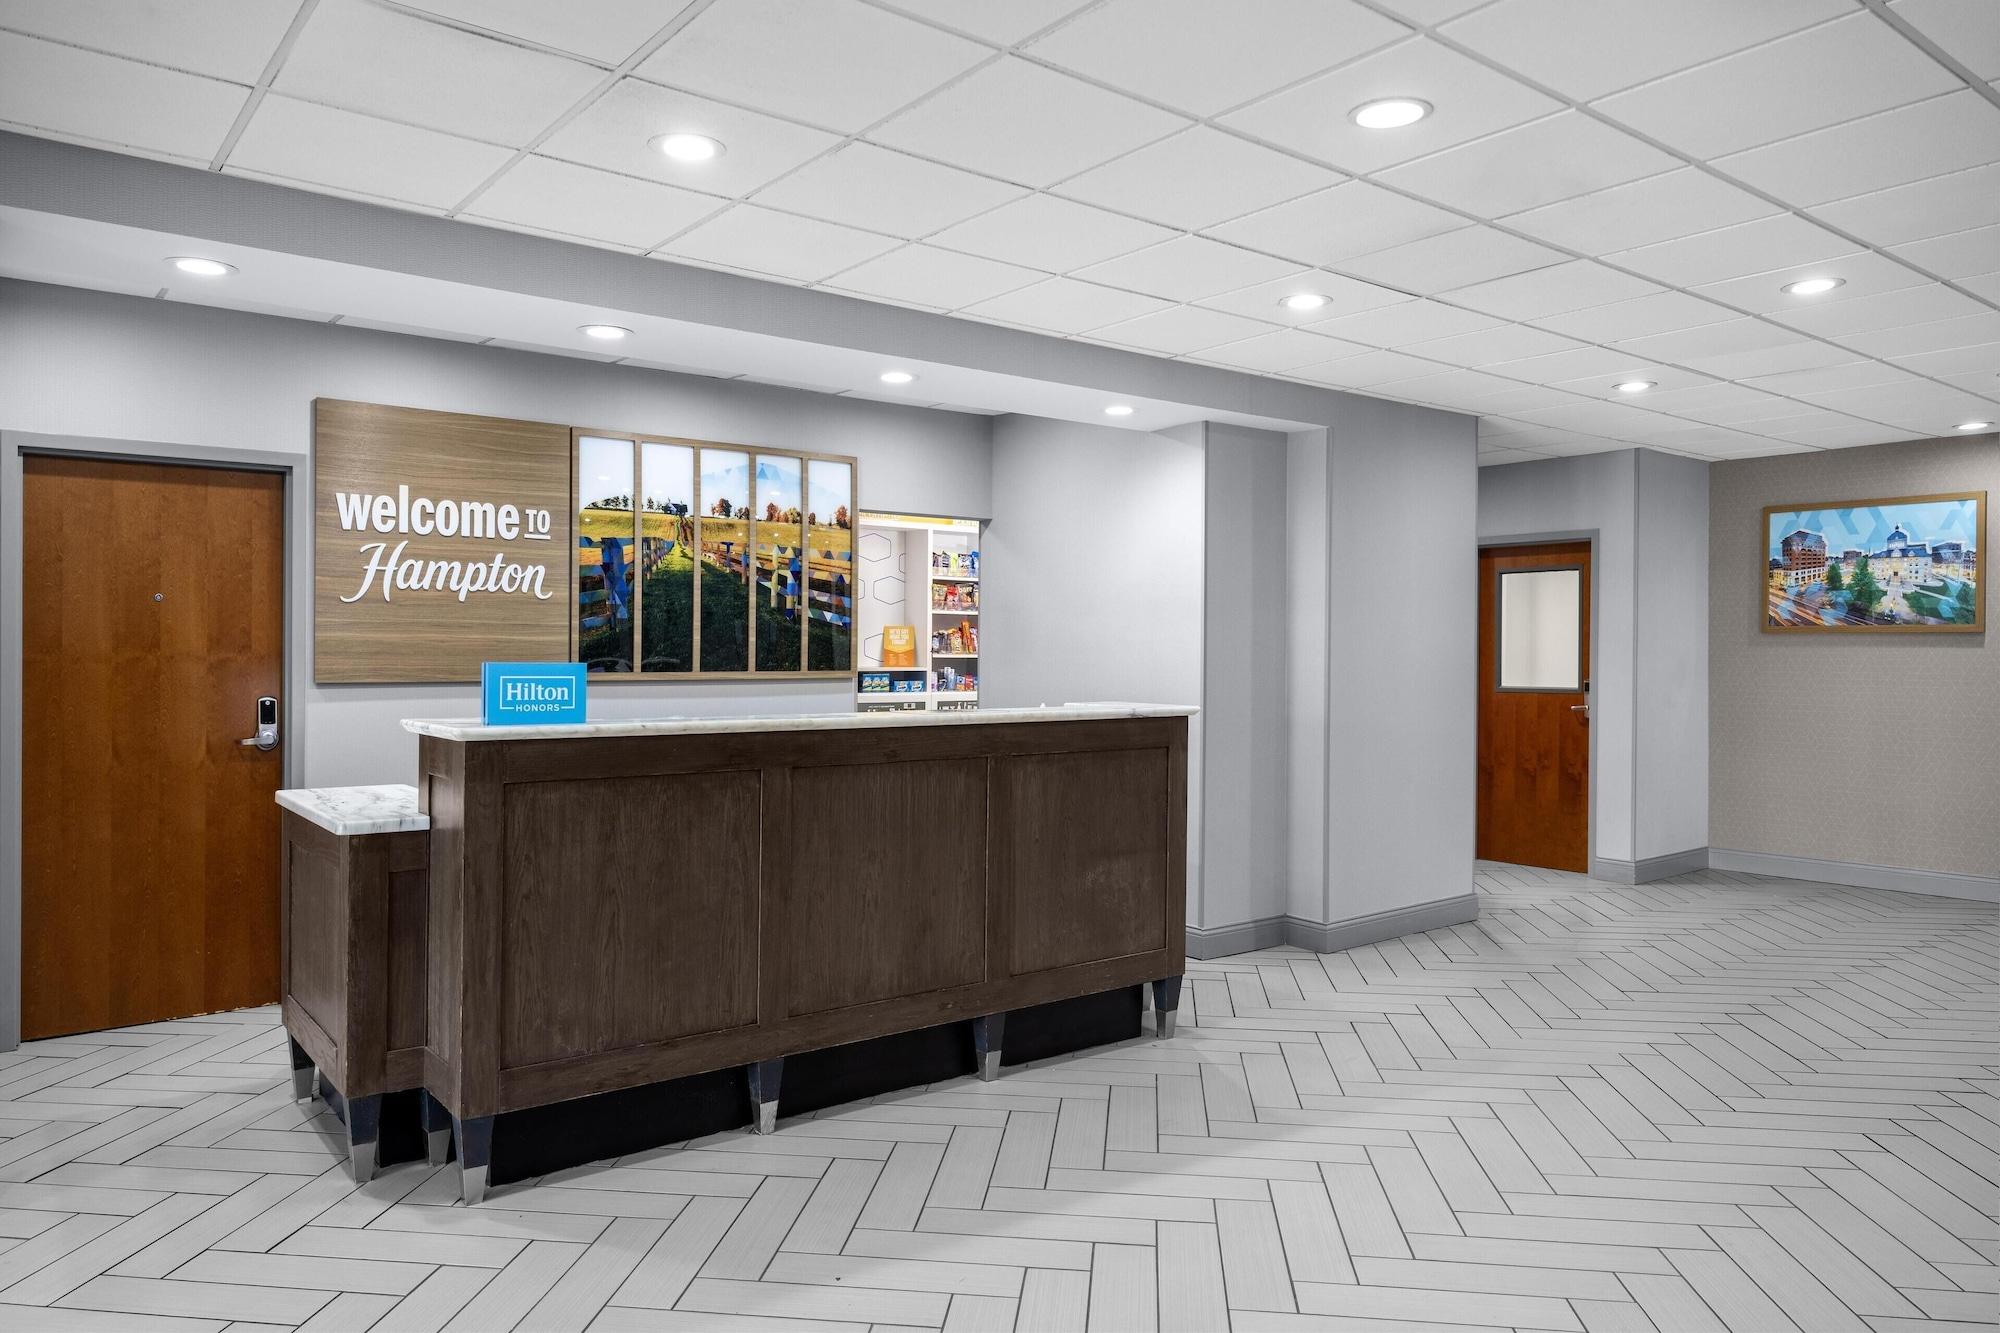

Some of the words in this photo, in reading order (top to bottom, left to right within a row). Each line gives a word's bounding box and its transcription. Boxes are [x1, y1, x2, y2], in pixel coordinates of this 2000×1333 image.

[335, 485, 520, 540] welcome
[525, 509, 551, 534] TO
[339, 540, 553, 603] Hampton
[506, 682, 569, 701] Hilton
[515, 704, 560, 712] HONORS
